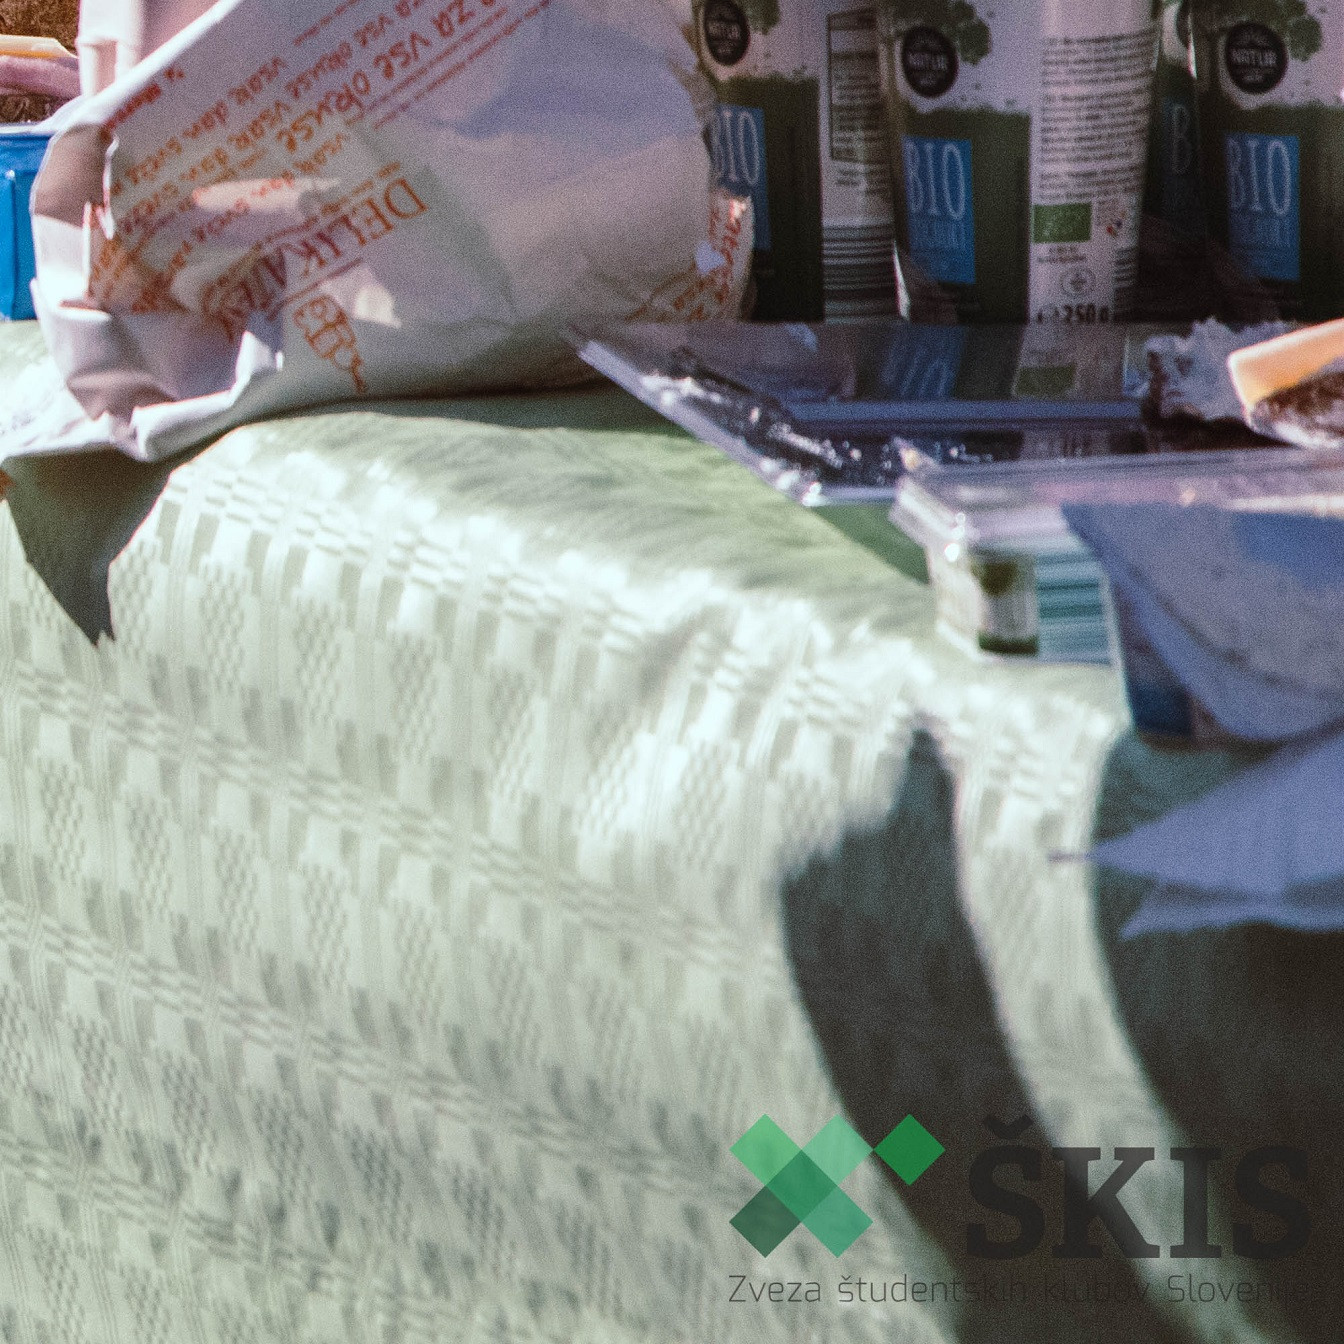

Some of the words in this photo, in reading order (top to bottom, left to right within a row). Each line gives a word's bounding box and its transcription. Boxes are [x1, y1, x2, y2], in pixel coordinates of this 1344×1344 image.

[370, 28, 432, 83] vse
[274, 68, 376, 154] okuse
[906, 142, 967, 220] BIO
[1227, 137, 1291, 217] BIO
